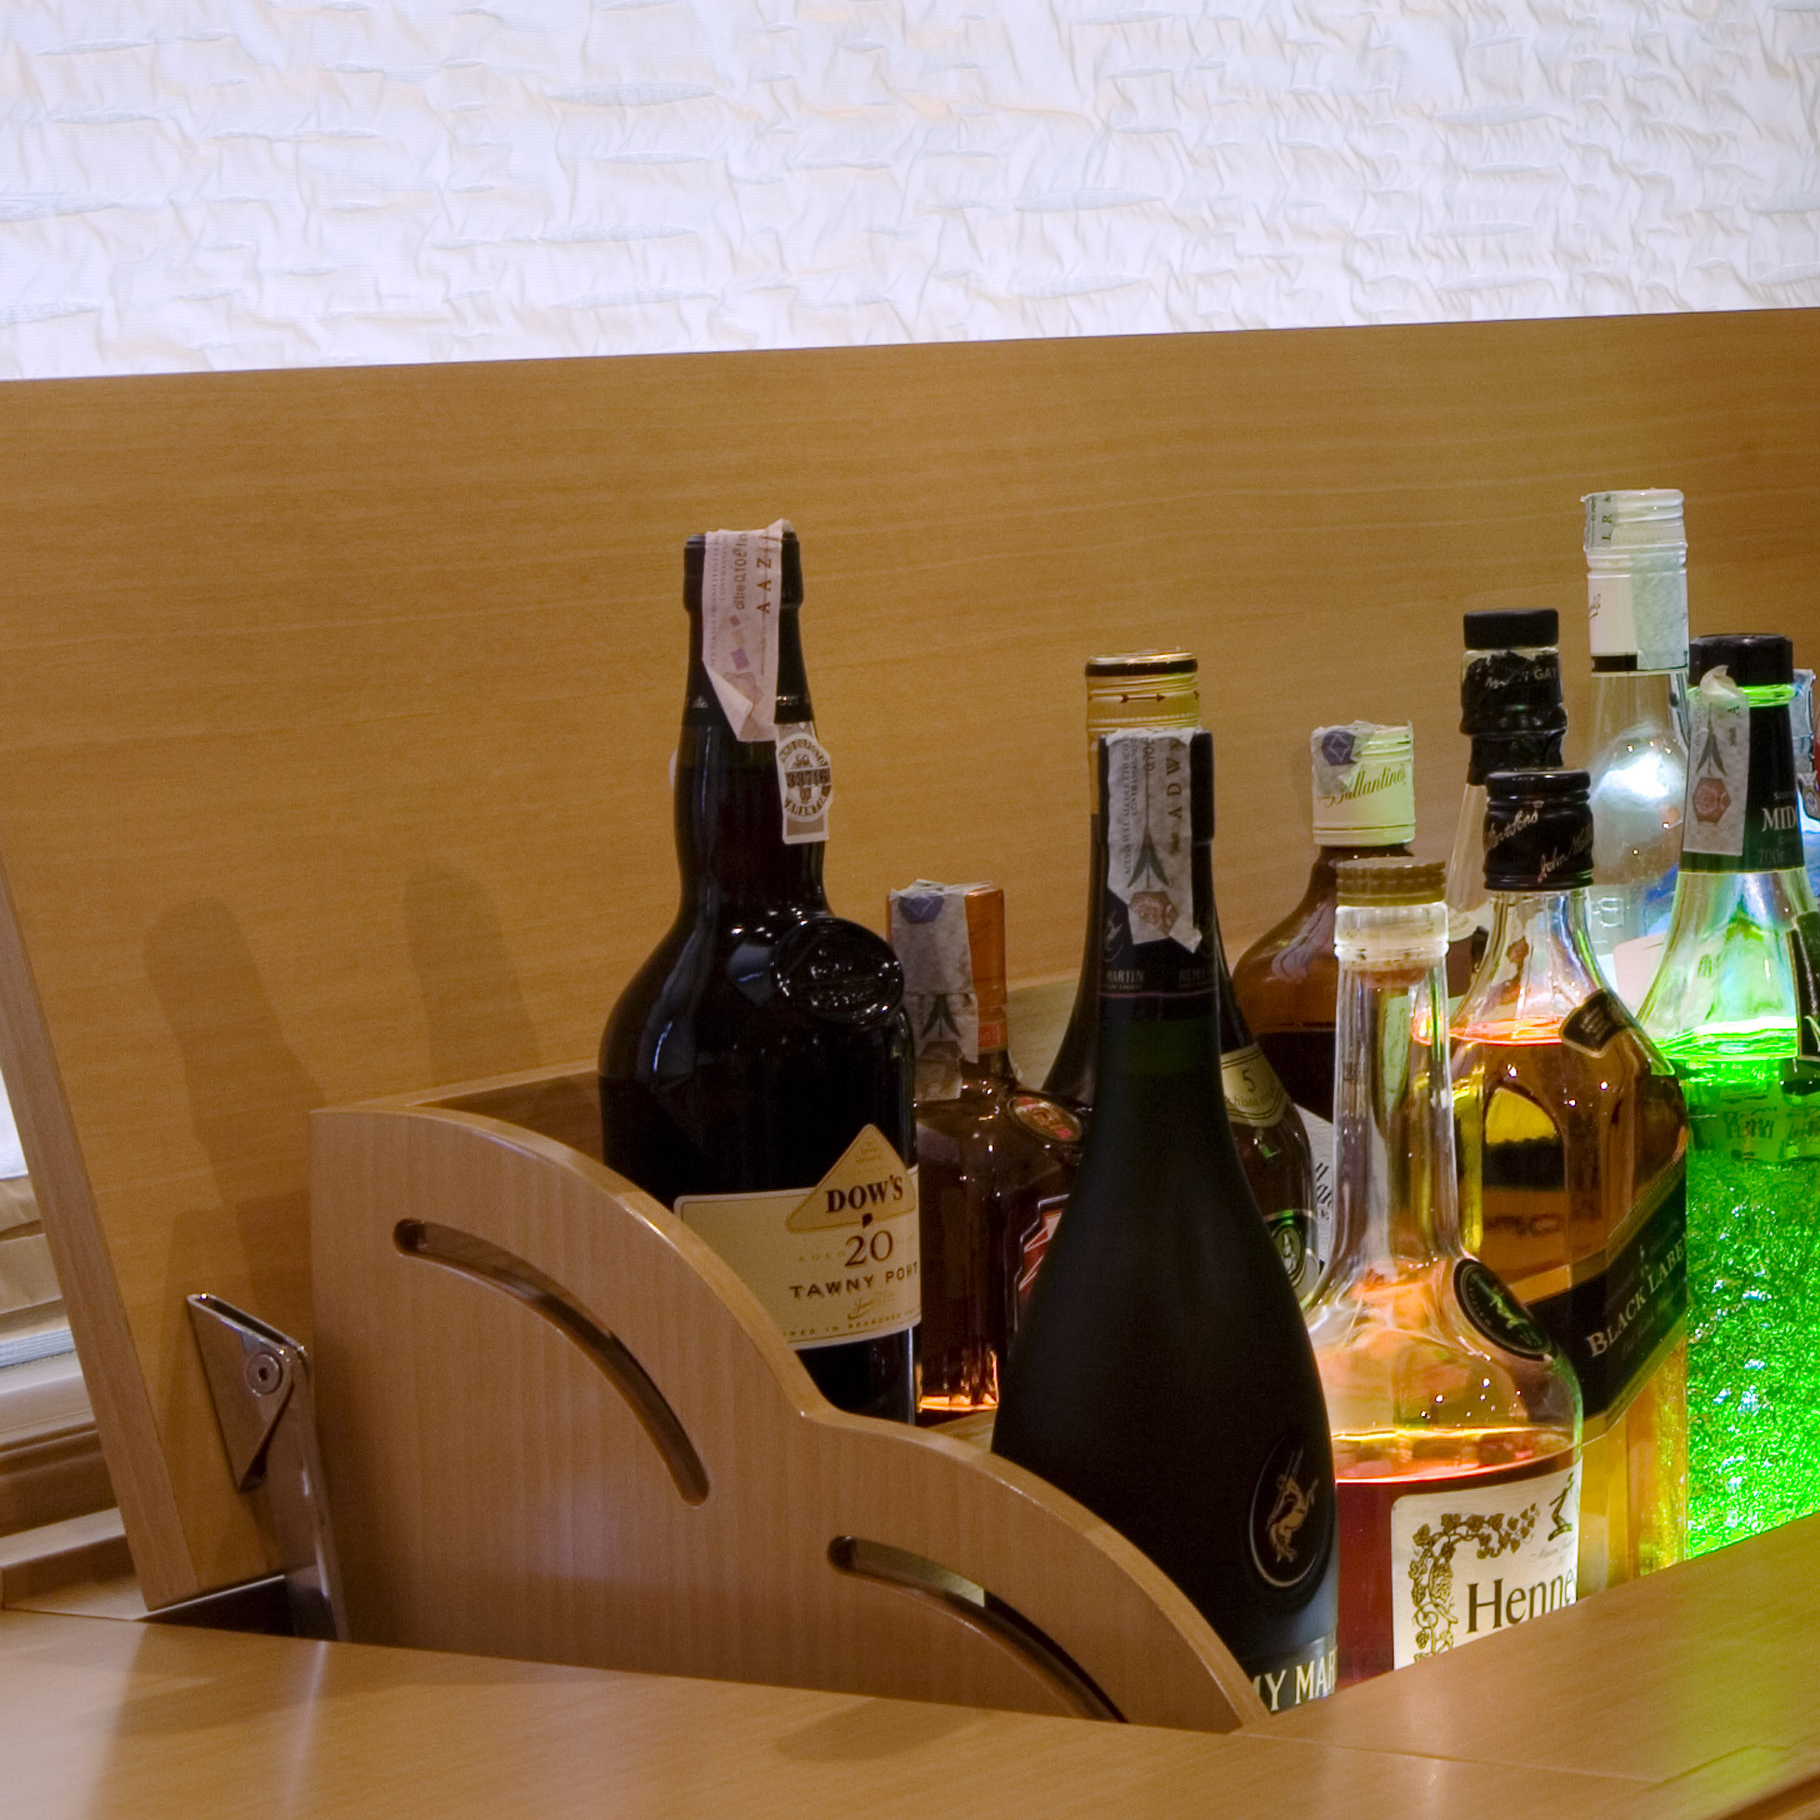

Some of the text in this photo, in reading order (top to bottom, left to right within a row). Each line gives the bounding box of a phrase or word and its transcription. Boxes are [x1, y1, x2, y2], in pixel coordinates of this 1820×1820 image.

[825, 1174, 904, 1214] DOW'S
[845, 1230, 894, 1268] 20
[788, 1261, 919, 1299] TAWNY PORT
[1585, 1285, 1647, 1358] BLACK
[1466, 1566, 1578, 1634] Henne
[1294, 1646, 1338, 1705] MAR
